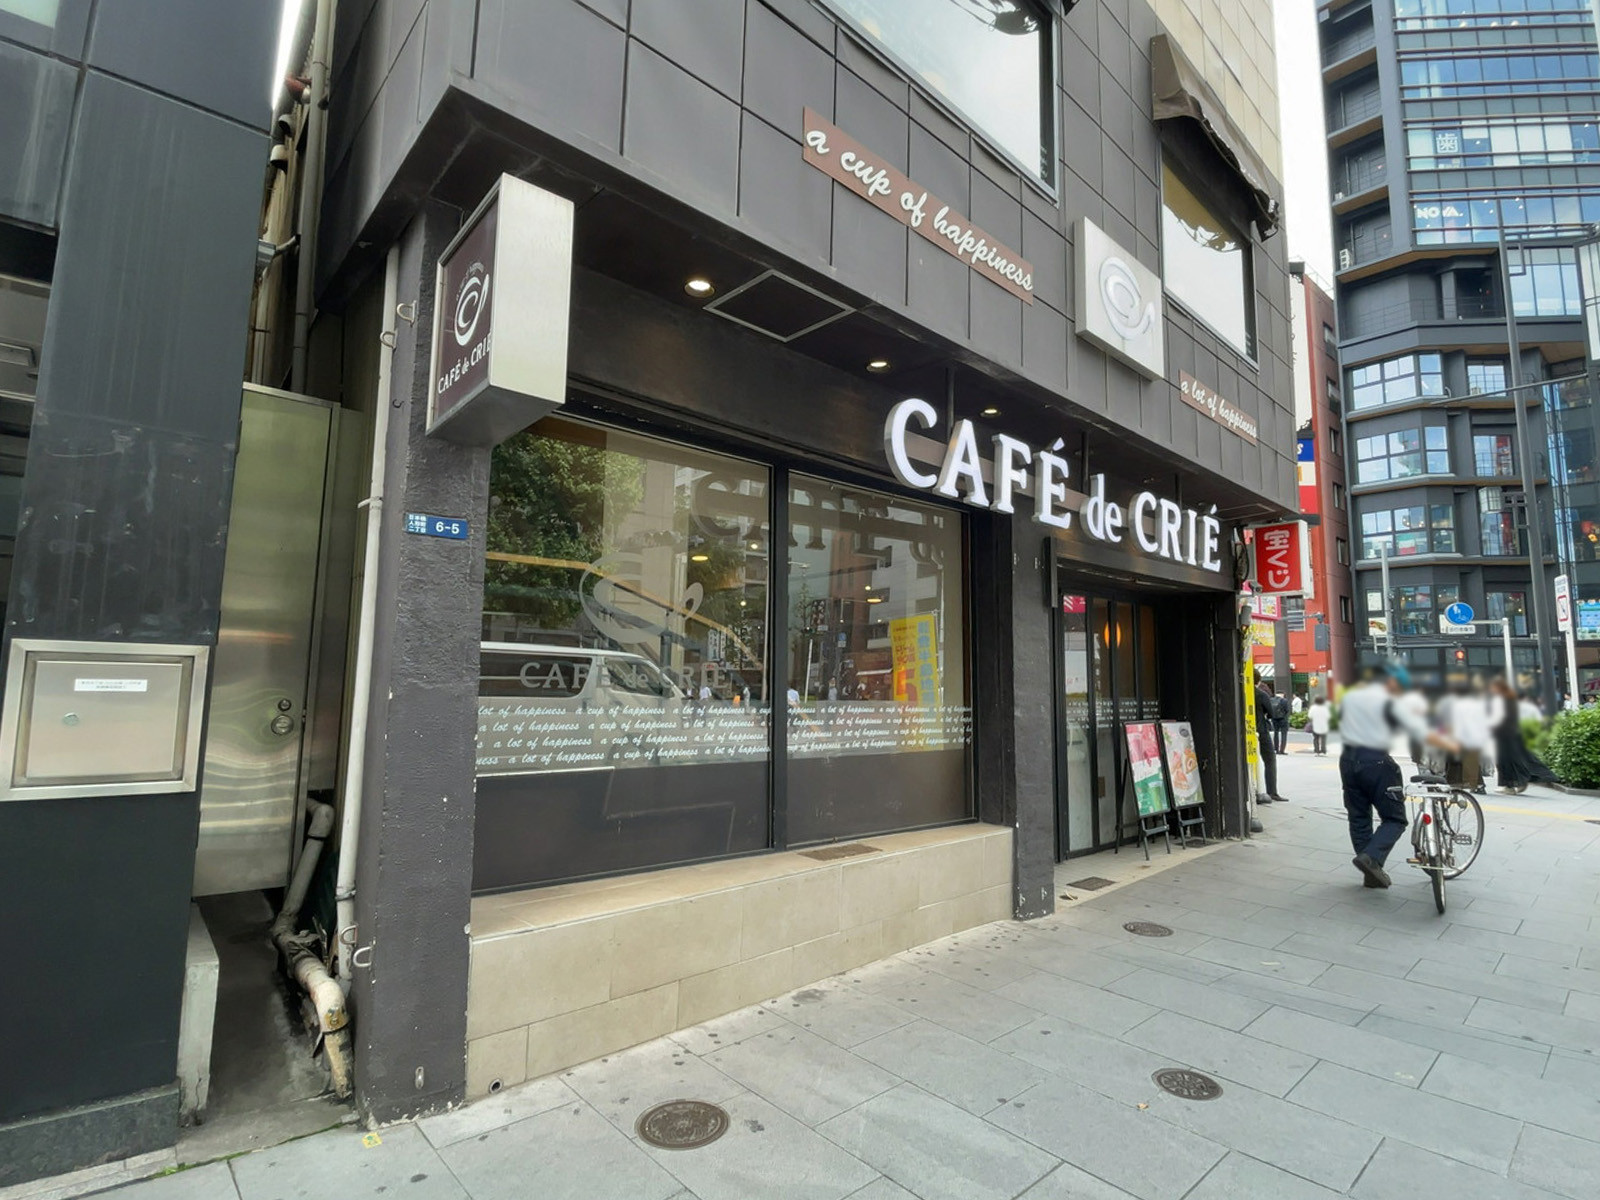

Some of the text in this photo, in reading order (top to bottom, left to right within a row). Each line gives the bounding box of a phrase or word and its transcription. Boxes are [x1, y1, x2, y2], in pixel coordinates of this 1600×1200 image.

[1435, 133, 1459, 153] 歯
[806, 130, 1034, 291] a cup of happiness
[437, 358, 461, 394] CAFÉ
[1180, 379, 1258, 438] a lot of happiness
[884, 397, 1071, 530] CAFÉ
[1080, 472, 1123, 543] de
[1128, 490, 1221, 573] CRIÉ
[435, 521, 460, 535] 6-5
[1263, 530, 1291, 589] 宝くじ
